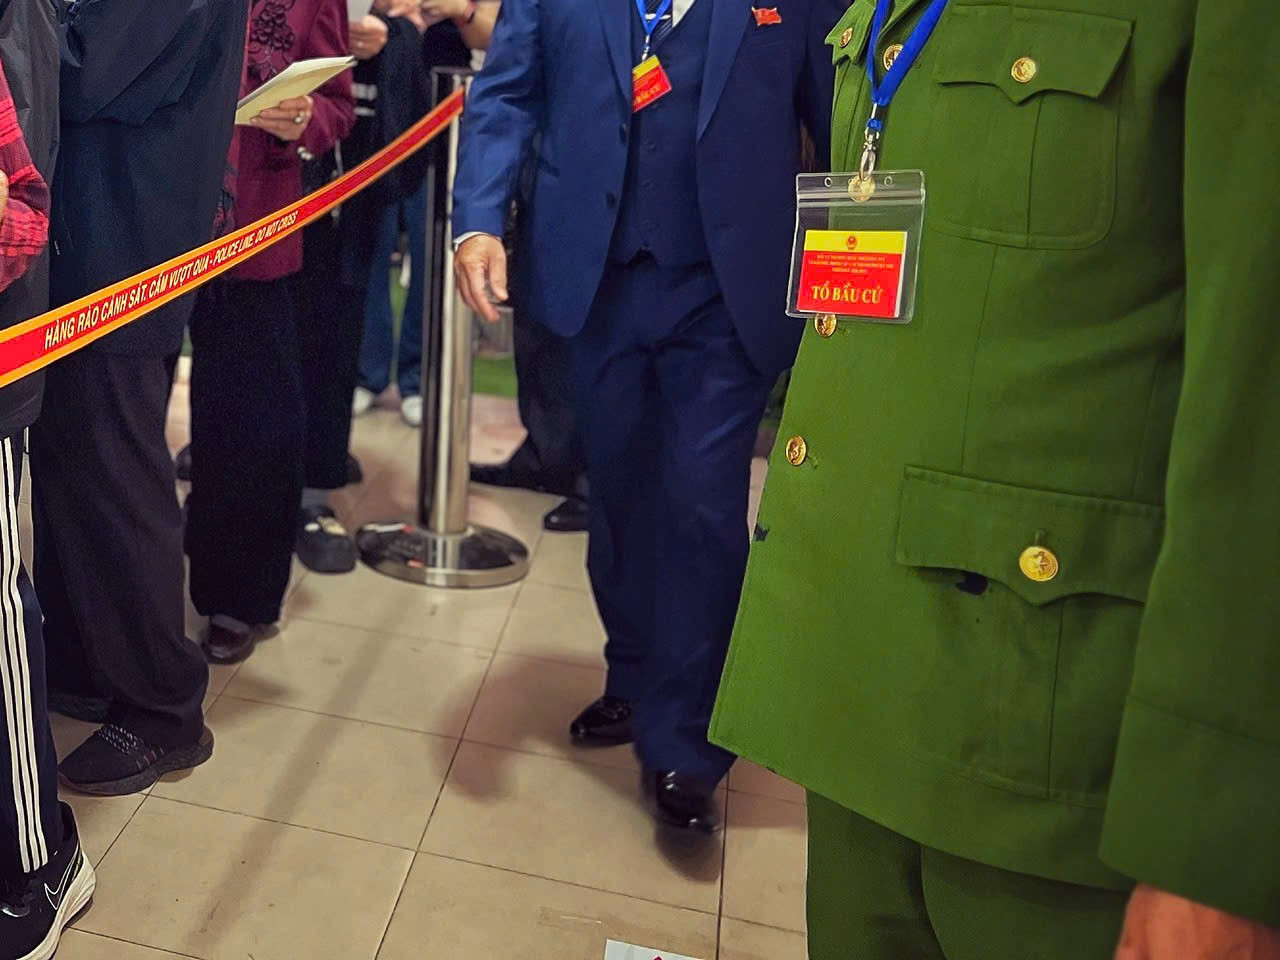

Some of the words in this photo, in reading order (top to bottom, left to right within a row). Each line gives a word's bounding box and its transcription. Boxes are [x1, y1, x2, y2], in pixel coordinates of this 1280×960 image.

[44, 317, 75, 350] HÀNG
[77, 305, 99, 333] RÀO
[148, 271, 169, 298] CẤM
[169, 261, 194, 288] VƯỢT
[193, 255, 210, 276] QUA
[212, 239, 240, 266] POLICE
[254, 226, 267, 244] DO
[265, 219, 280, 238] NOT
[811, 280, 830, 300] TỔ
[832, 282, 860, 303] BẦU
[862, 285, 883, 304] CỬ
